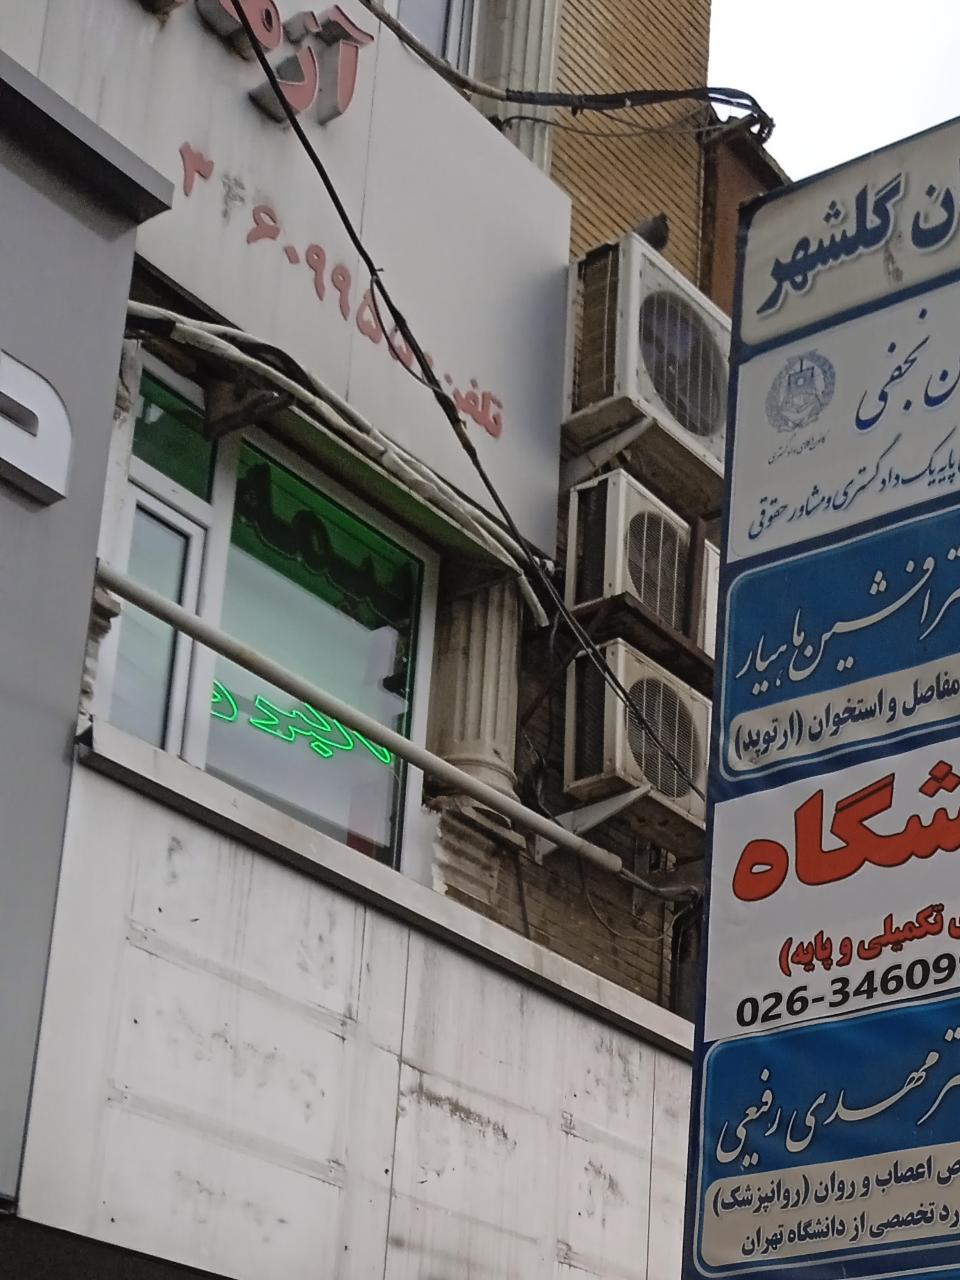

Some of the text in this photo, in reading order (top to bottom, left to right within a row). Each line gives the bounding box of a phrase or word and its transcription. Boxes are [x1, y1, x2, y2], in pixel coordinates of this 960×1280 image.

[757, 172, 904, 315] گلشهر
[855, 308, 931, 431] نجفی
[748, 496, 788, 540] حقوقی
[787, 485, 825, 522] مشاور
[788, 556, 936, 682] افشین
[807, 688, 884, 742] استخوان
[886, 701, 897, 723] و
[901, 671, 960, 718] مفاصل
[734, 709, 802, 761] (ارتوپد)
[778, 929, 833, 977] پایه)
[836, 935, 853, 967] و
[857, 903, 945, 961] تکمیلی
[716, 1067, 781, 1168] رفیعی
[785, 1050, 940, 1152] مهدی
[813, 1175, 856, 1204] روان
[861, 1175, 870, 1197] و
[874, 1155, 933, 1193] اعصاب
[712, 1175, 810, 1217] (روانپزشک)
[740, 1224, 785, 1256] تهران
[787, 1213, 846, 1244] دانشگاه
[848, 1212, 866, 1243] از
[868, 1202, 935, 1239] تخصصی
